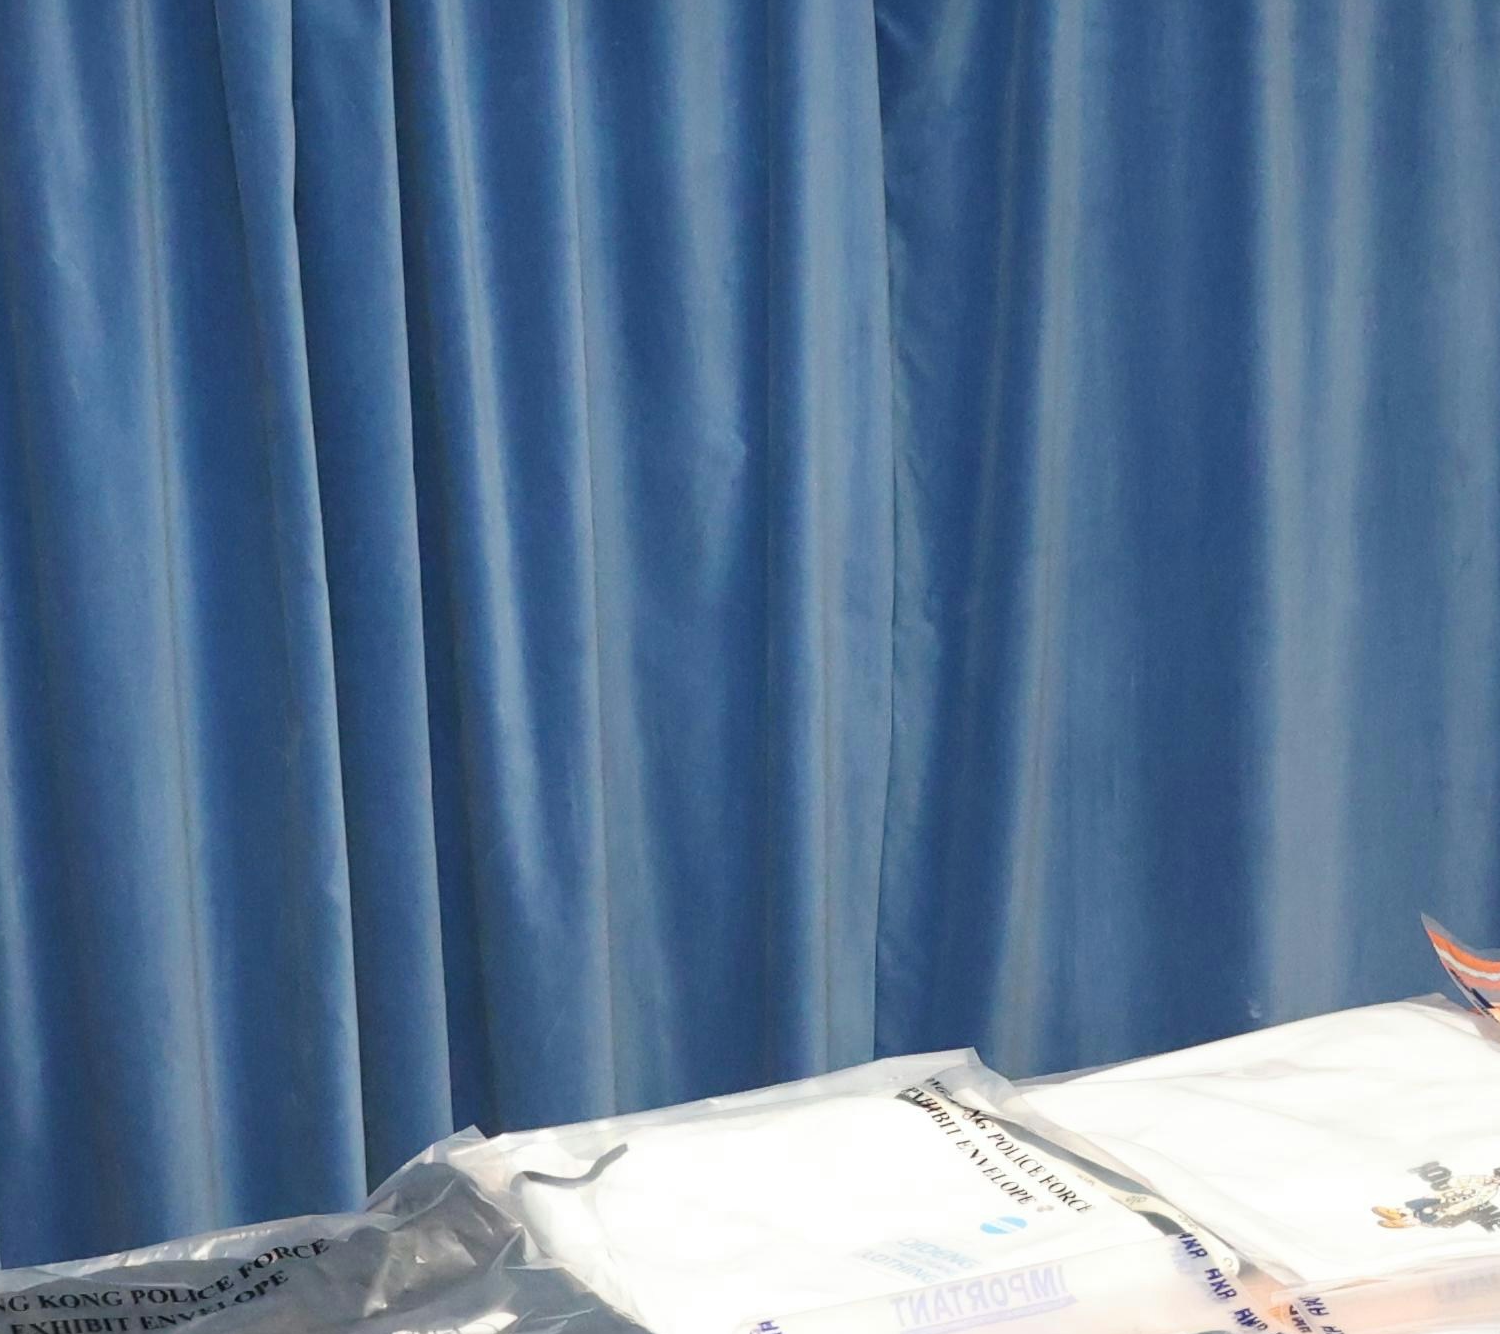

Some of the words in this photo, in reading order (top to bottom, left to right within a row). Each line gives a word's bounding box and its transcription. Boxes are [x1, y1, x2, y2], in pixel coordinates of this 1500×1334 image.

[955, 1139, 1037, 1205] ENVELOPE
[987, 1132, 1047, 1177] POLICE
[1038, 1174, 1095, 1213] FORCE
[37, 1290, 123, 1311] KONG
[130, 1275, 235, 1306] POLICE
[238, 1238, 331, 1280] FORCE
[140, 1270, 290, 1331] ENVELOPE
